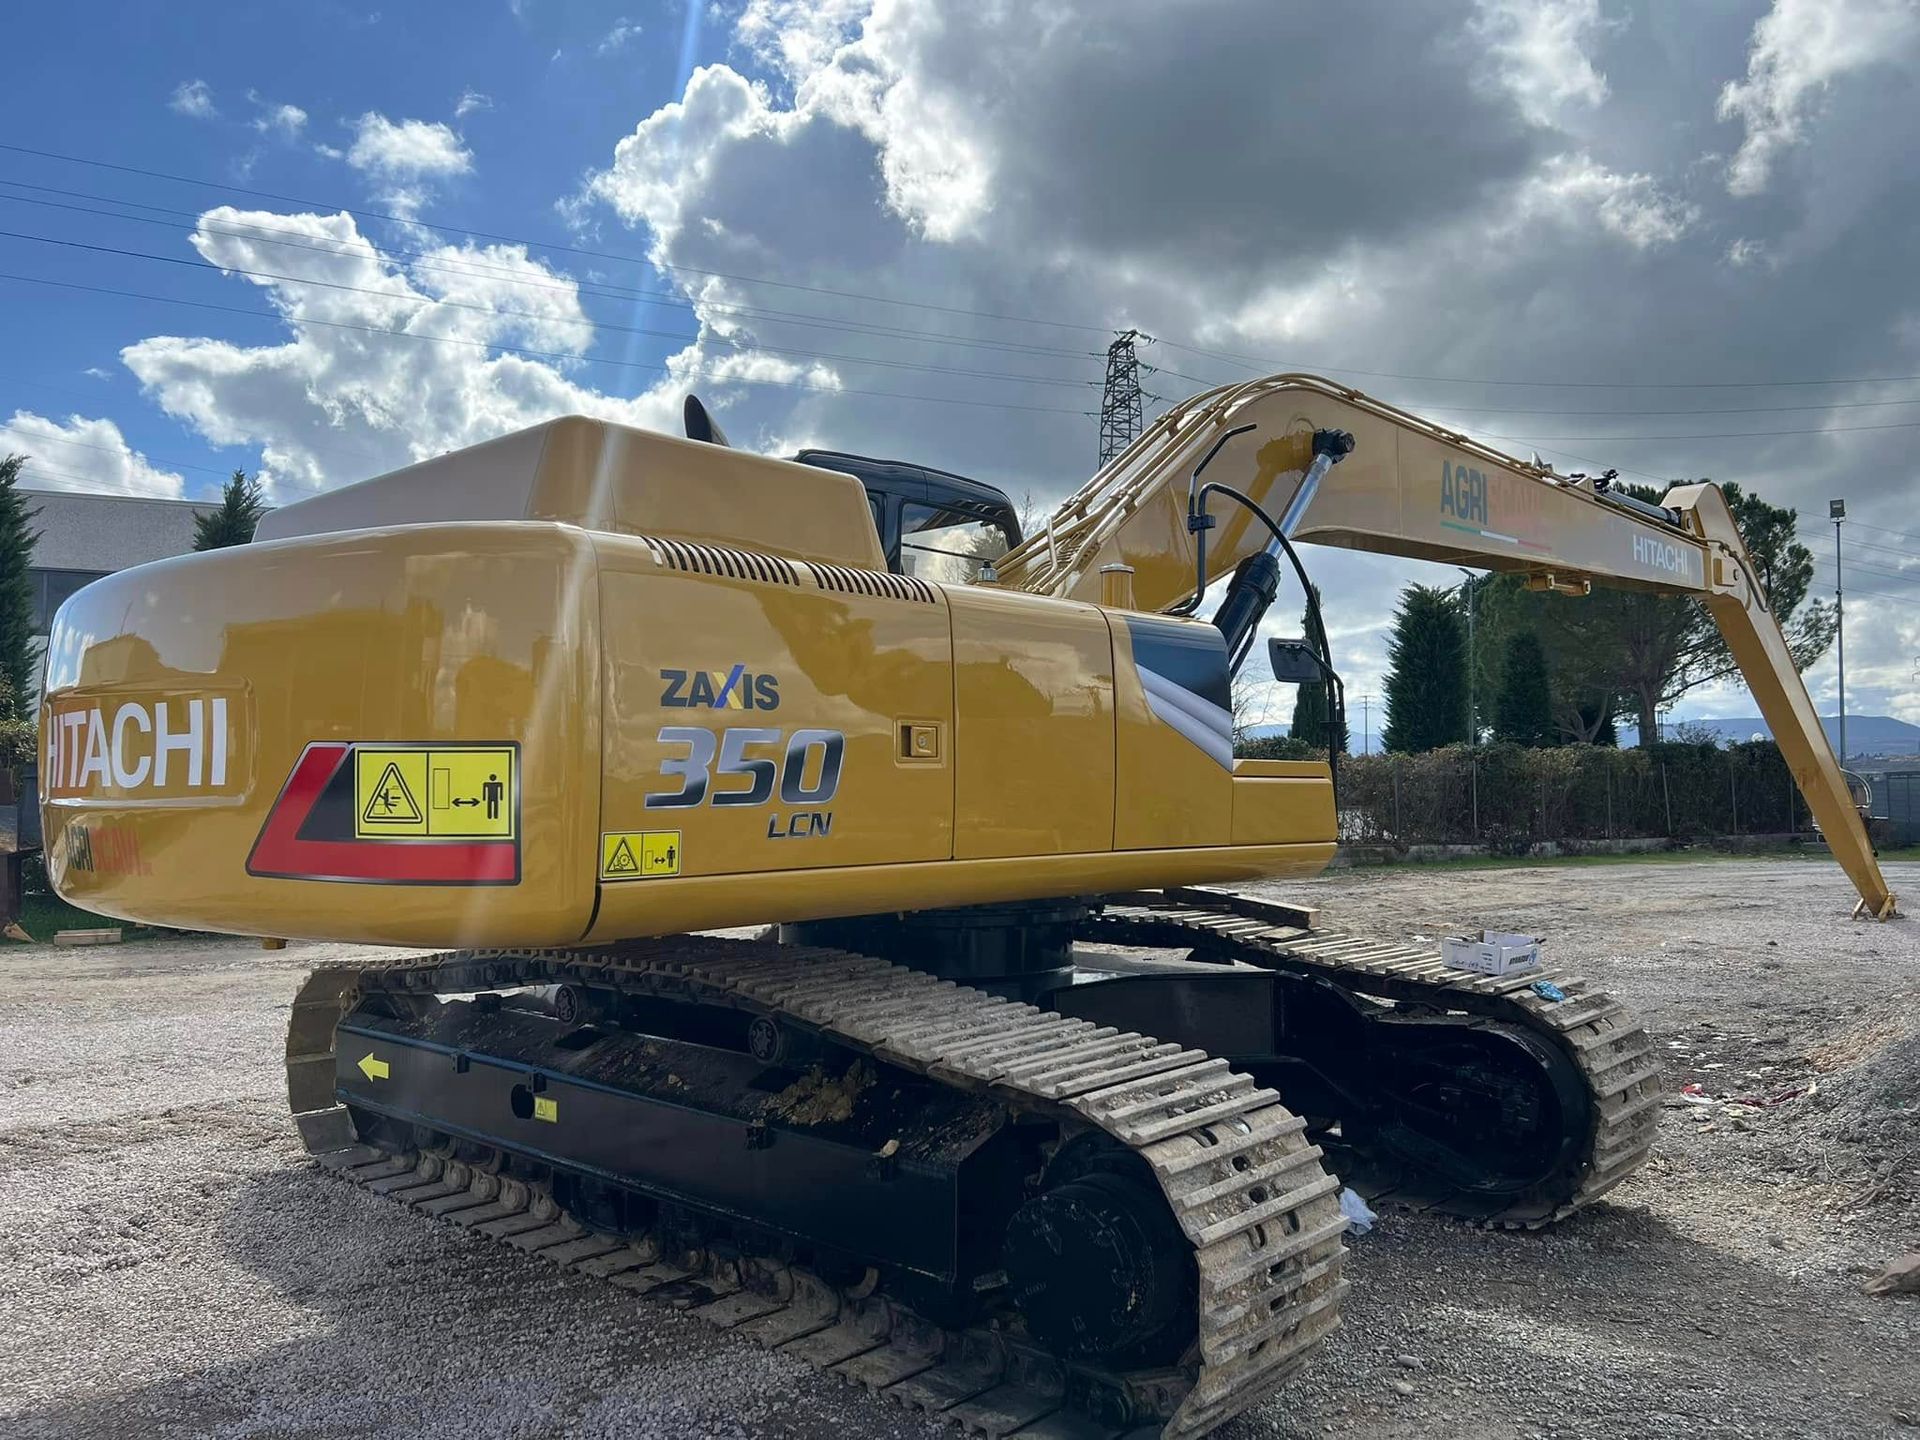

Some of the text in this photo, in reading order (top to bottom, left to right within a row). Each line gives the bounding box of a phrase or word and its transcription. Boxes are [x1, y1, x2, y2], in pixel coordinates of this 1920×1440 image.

[1633, 534, 1689, 575] HITACHI
[660, 664, 780, 711] ZAXIS
[47, 698, 227, 789] HITACHI
[644, 726, 846, 809] 350
[767, 812, 832, 840] LCN
